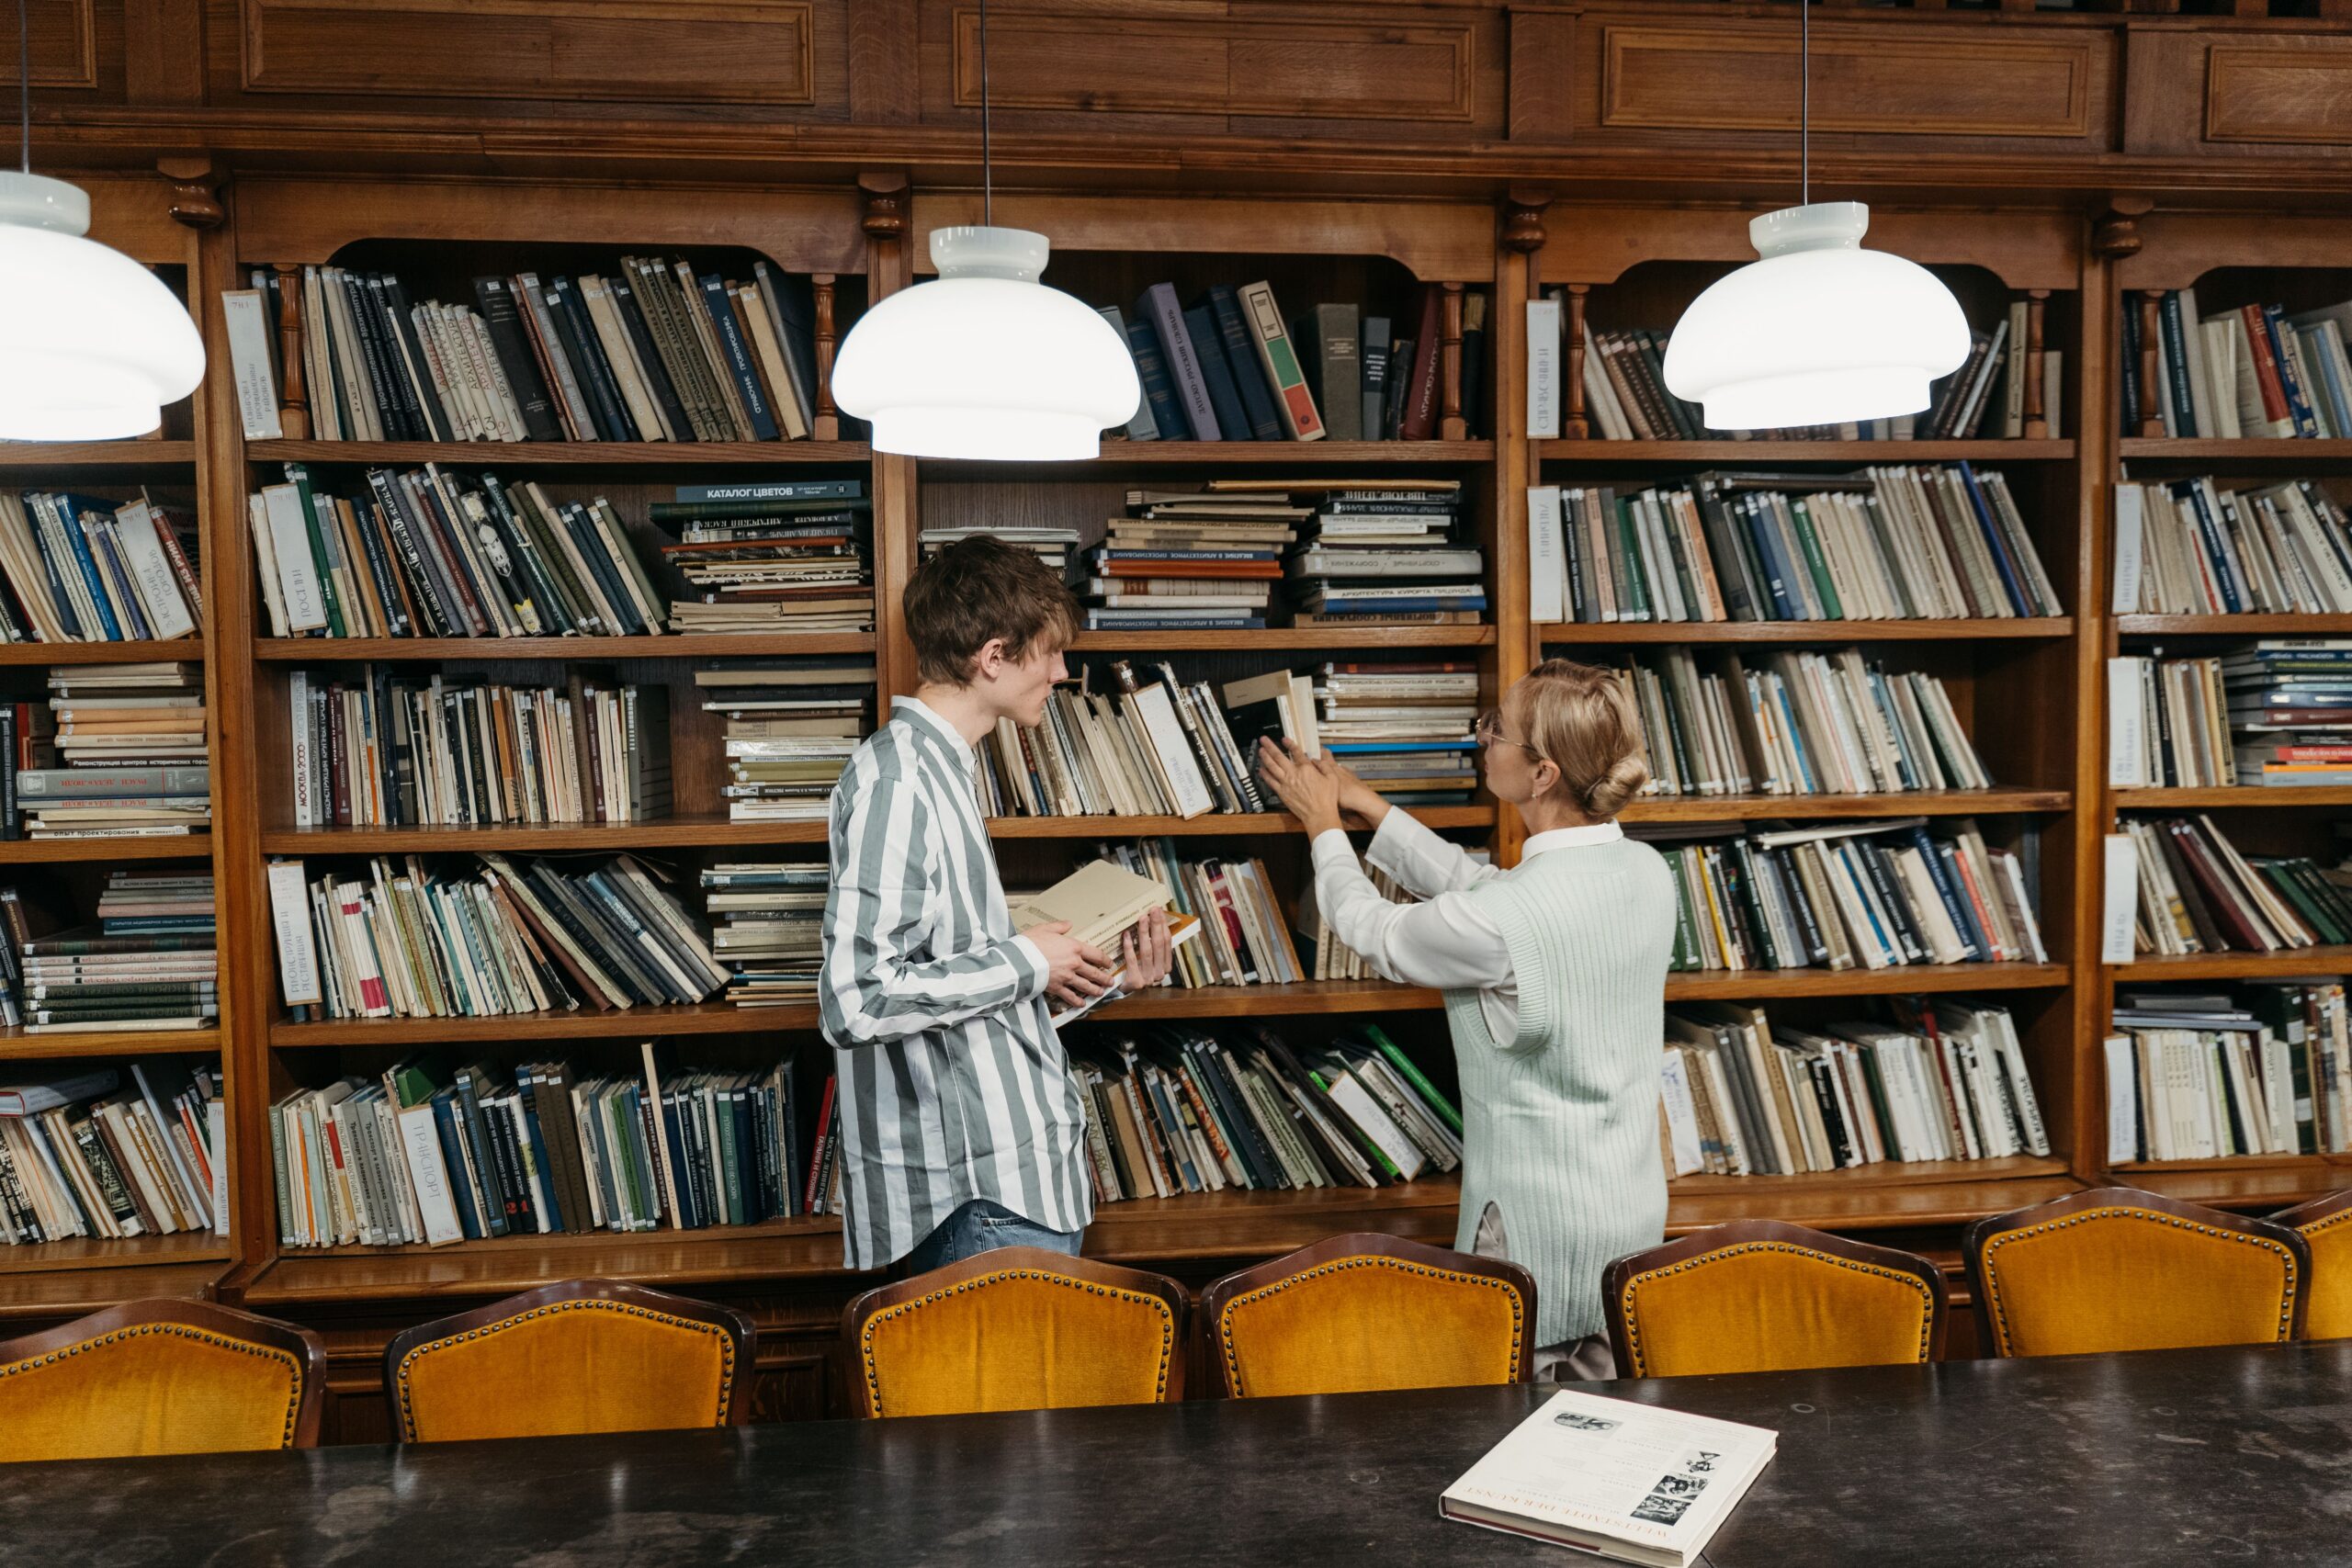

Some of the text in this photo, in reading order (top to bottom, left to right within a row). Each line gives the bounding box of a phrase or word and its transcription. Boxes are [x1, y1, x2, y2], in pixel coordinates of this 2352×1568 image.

[347, 282, 389, 410] Промышленная архитектура
[721, 314, 762, 414] СПРАВОЧНИК ПРОЕКТИРОВЩИКА
[707, 487, 792, 498] КАТАЛОГ ЦВЕТОВ
[1343, 491, 1425, 500] ЦВЕТОВЕДЕНИЕ
[730, 517, 782, 527] АНГАРСКИЙ
[165, 538, 185, 568] РУИН
[178, 567, 192, 583] ИЗ
[322, 759, 332, 818] РЕКОНСТРУКЦИЯ
[77, 829, 139, 837] проектирования
[553, 903, 621, 976] БОЛЬНИЦЫ
[506, 1134, 518, 1169] СООРУЖЕНИЯ
[722, 1114, 733, 1156] ПЕРЕХОДЫ
[813, 1134, 825, 1163] ГАРАЖИ
[410, 1122, 443, 1201] ТРАНСПОРТ
[492, 1137, 505, 1172] СООРУЖЕНИЯ
[817, 1135, 834, 1201] МОСТЫ ЛЕНИНГРАД
[349, 1122, 362, 1156] Транспорт
[367, 1201, 377, 1228] городов
[365, 1122, 378, 1156] Транспорт
[382, 1201, 393, 1228] городов
[502, 1179, 511, 1199] МОСТЫ
[515, 1175, 525, 1195] МОСТЫ
[806, 1170, 819, 1202] СТОЯНКИ
